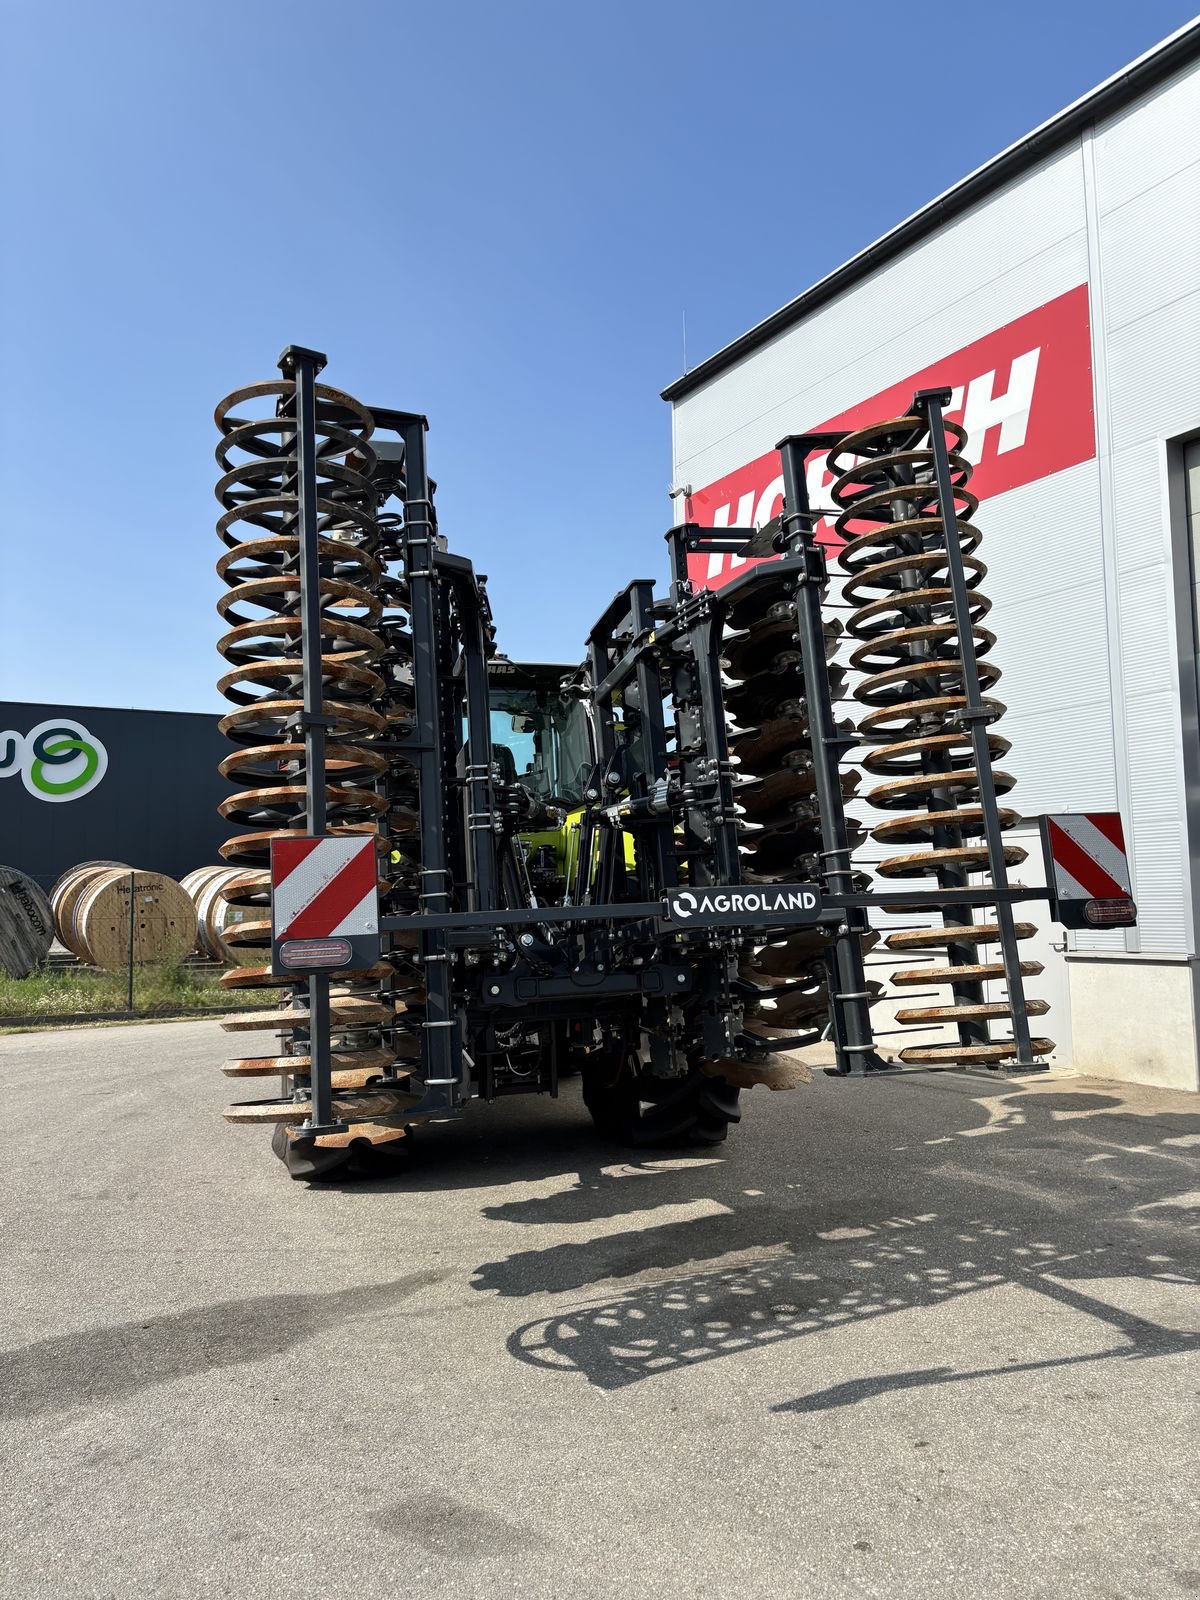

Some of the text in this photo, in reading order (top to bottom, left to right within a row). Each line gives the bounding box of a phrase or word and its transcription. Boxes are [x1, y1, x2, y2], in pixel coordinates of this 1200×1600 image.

[487, 665, 516, 674] AAS
[116, 883, 165, 895] Heatronic
[699, 892, 817, 913] AGROLAND
